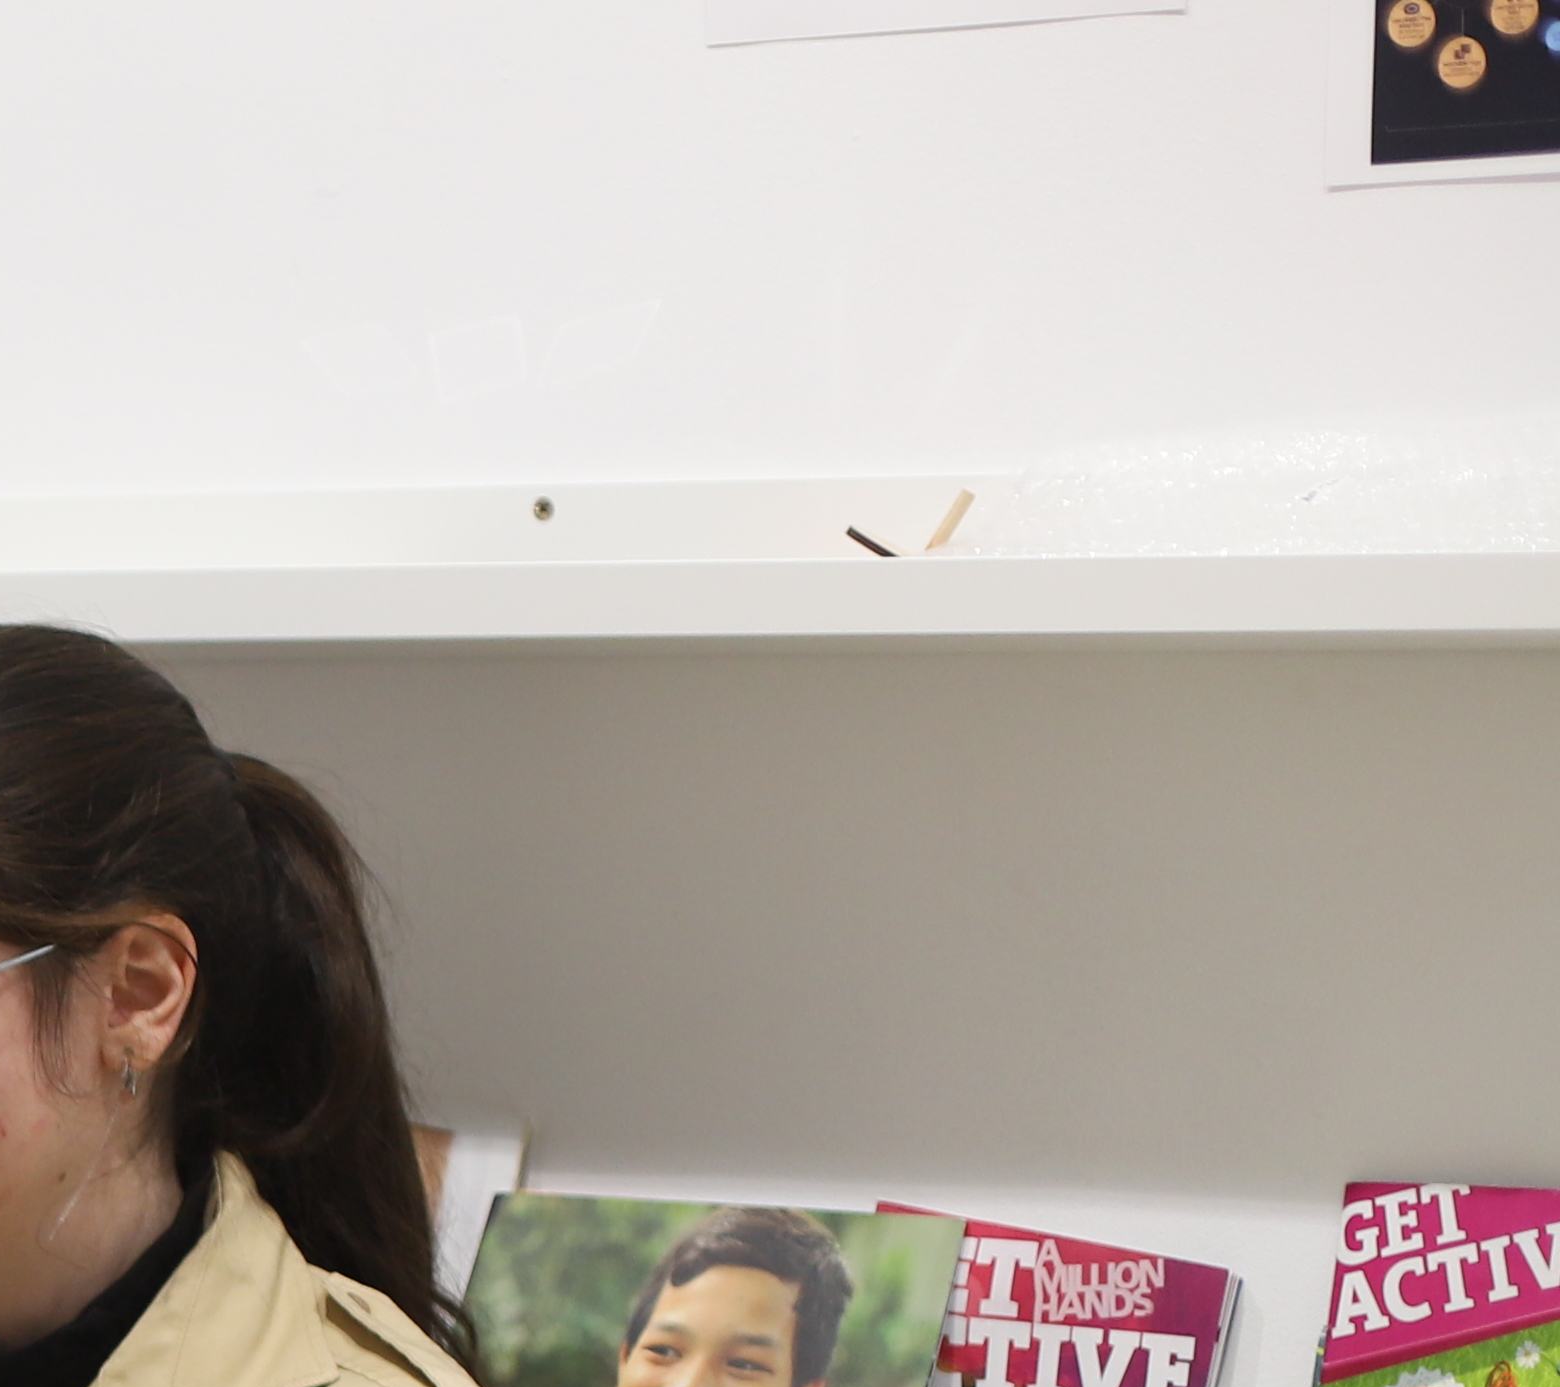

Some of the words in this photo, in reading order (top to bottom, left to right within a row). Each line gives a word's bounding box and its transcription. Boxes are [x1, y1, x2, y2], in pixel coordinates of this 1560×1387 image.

[1335, 1183, 1471, 1266] GET
[1036, 1238, 1064, 1266] A
[1033, 1257, 1165, 1297] MILLION
[1330, 1222, 1560, 1339] ACTIV
[1034, 1286, 1156, 1323] HANDS
